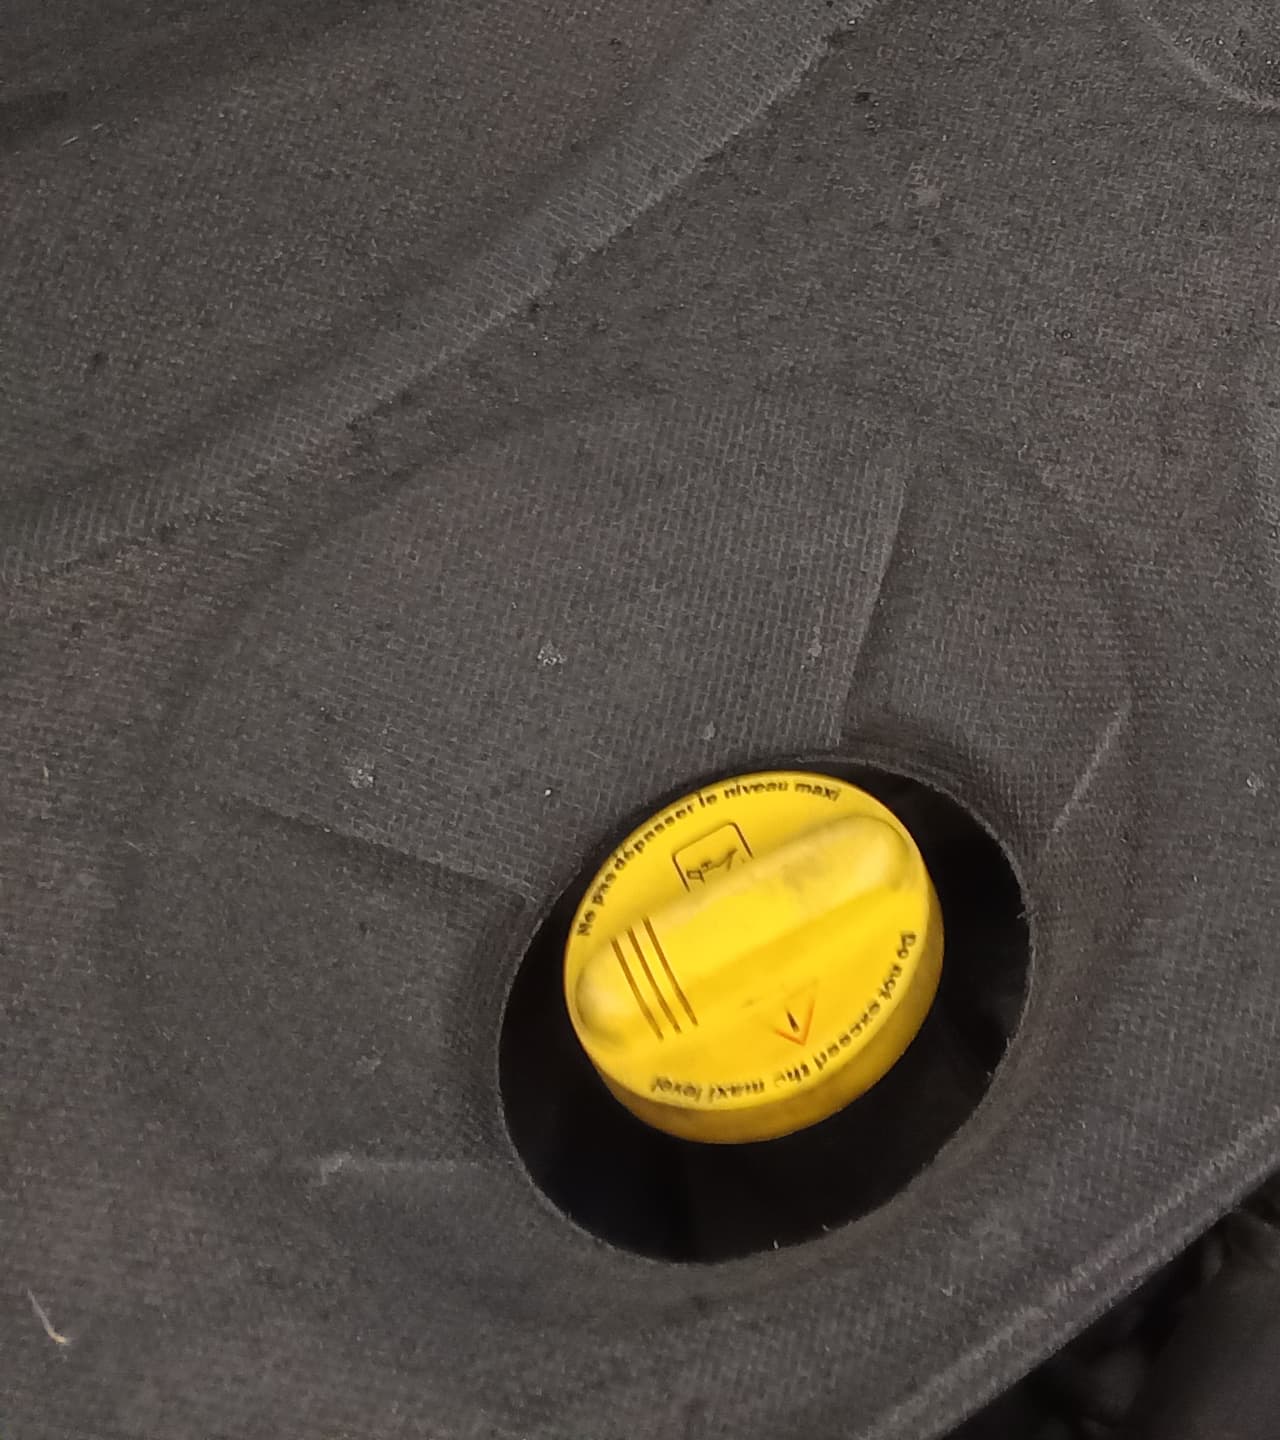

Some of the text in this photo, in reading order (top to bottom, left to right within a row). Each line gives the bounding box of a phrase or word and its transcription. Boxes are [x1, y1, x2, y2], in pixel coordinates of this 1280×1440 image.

[576, 779, 842, 937] Ne pas dépasser le niveau maxi
[651, 931, 918, 1103] Do not exceed the maxi level
